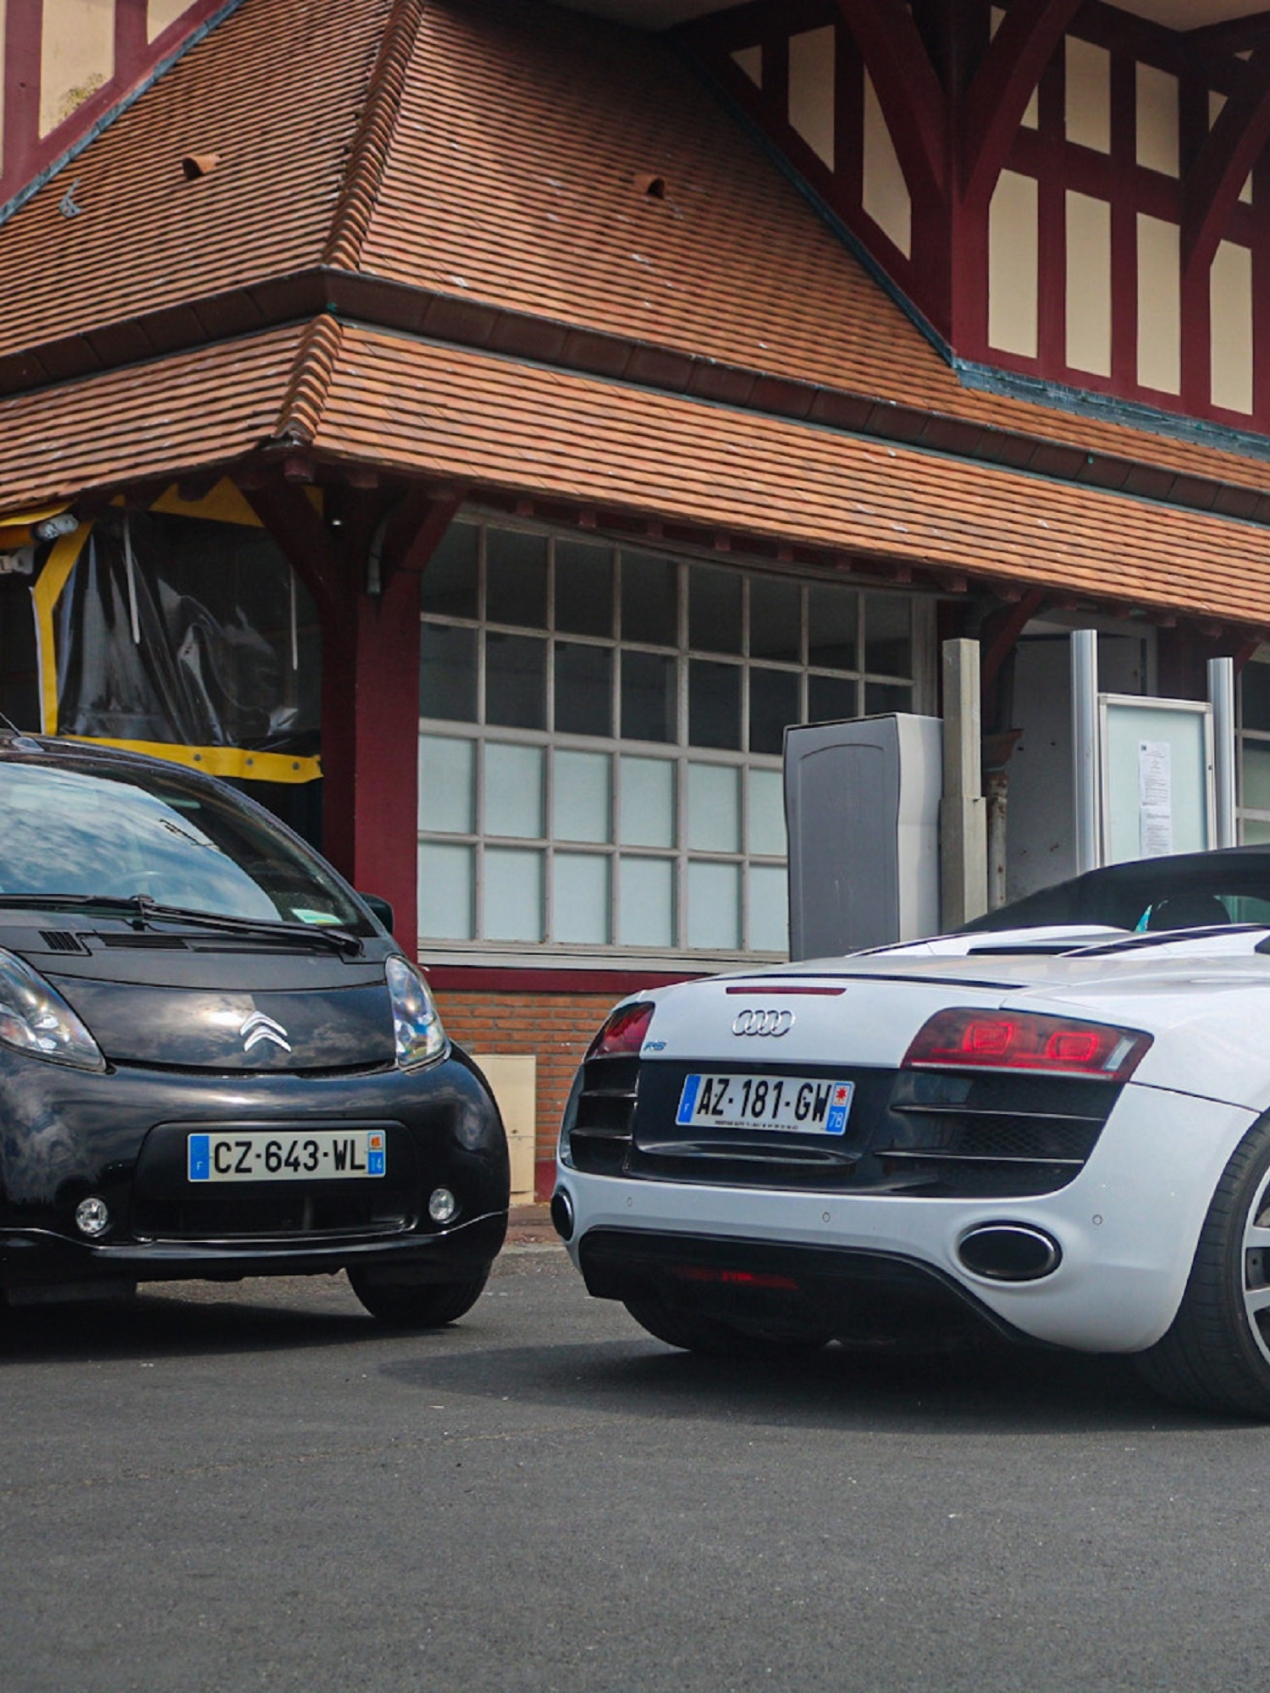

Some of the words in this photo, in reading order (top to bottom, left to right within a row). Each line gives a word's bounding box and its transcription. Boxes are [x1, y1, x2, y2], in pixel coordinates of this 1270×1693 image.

[696, 1077, 832, 1122] AZ-181-GW
[196, 1161, 203, 1170] F
[214, 1139, 366, 1173] CZ-643-WL
[371, 1156, 382, 1171] 14
